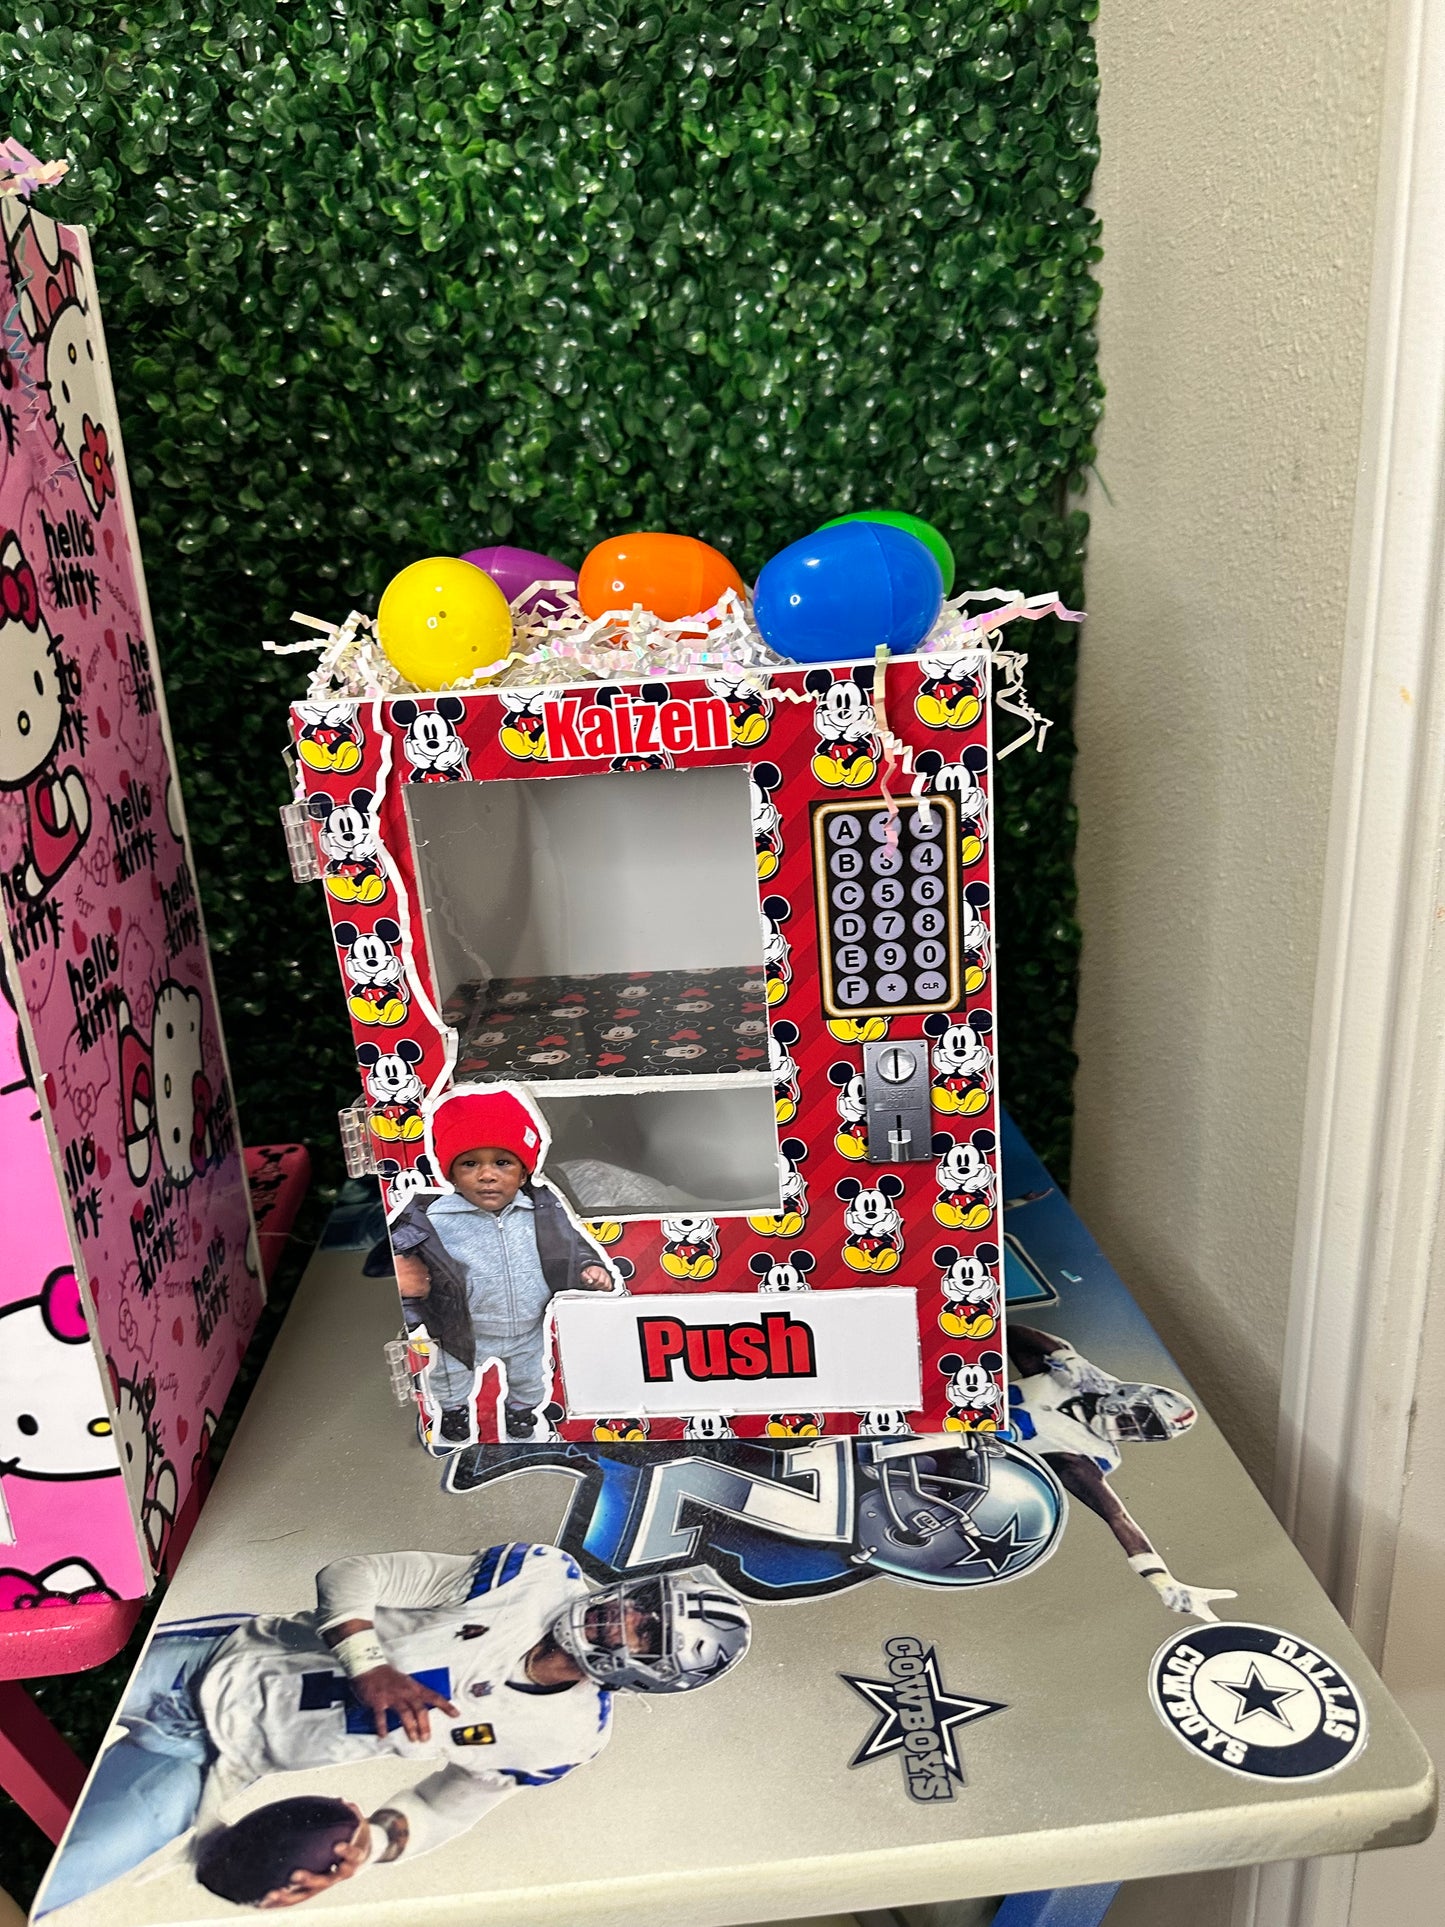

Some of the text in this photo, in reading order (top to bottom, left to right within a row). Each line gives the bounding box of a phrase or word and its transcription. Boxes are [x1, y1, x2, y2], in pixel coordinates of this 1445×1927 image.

[41, 509, 95, 558] hello
[46, 559, 101, 615] kitty
[543, 695, 731, 760] Kaizen
[106, 779, 152, 835] hello
[837, 820, 854, 839] A
[113, 827, 158, 882] kitty
[839, 854, 855, 872] B
[920, 848, 934, 866] 4
[840, 882, 935, 905] C 5 6
[842, 914, 936, 936] D 7 8
[66, 933, 119, 1006] hello
[844, 950, 859, 967] E
[884, 948, 897, 965] 9
[847, 981, 860, 998] F
[135, 1217, 178, 1302] kitty
[192, 1230, 226, 1311] hello
[197, 1274, 230, 1350] kitty
[637, 1312, 817, 1382] Push
[1163, 1644, 1248, 1764] COWBOYS
[1271, 1637, 1357, 1742] DALLAS
[885, 1637, 953, 1799] COWBOYS
